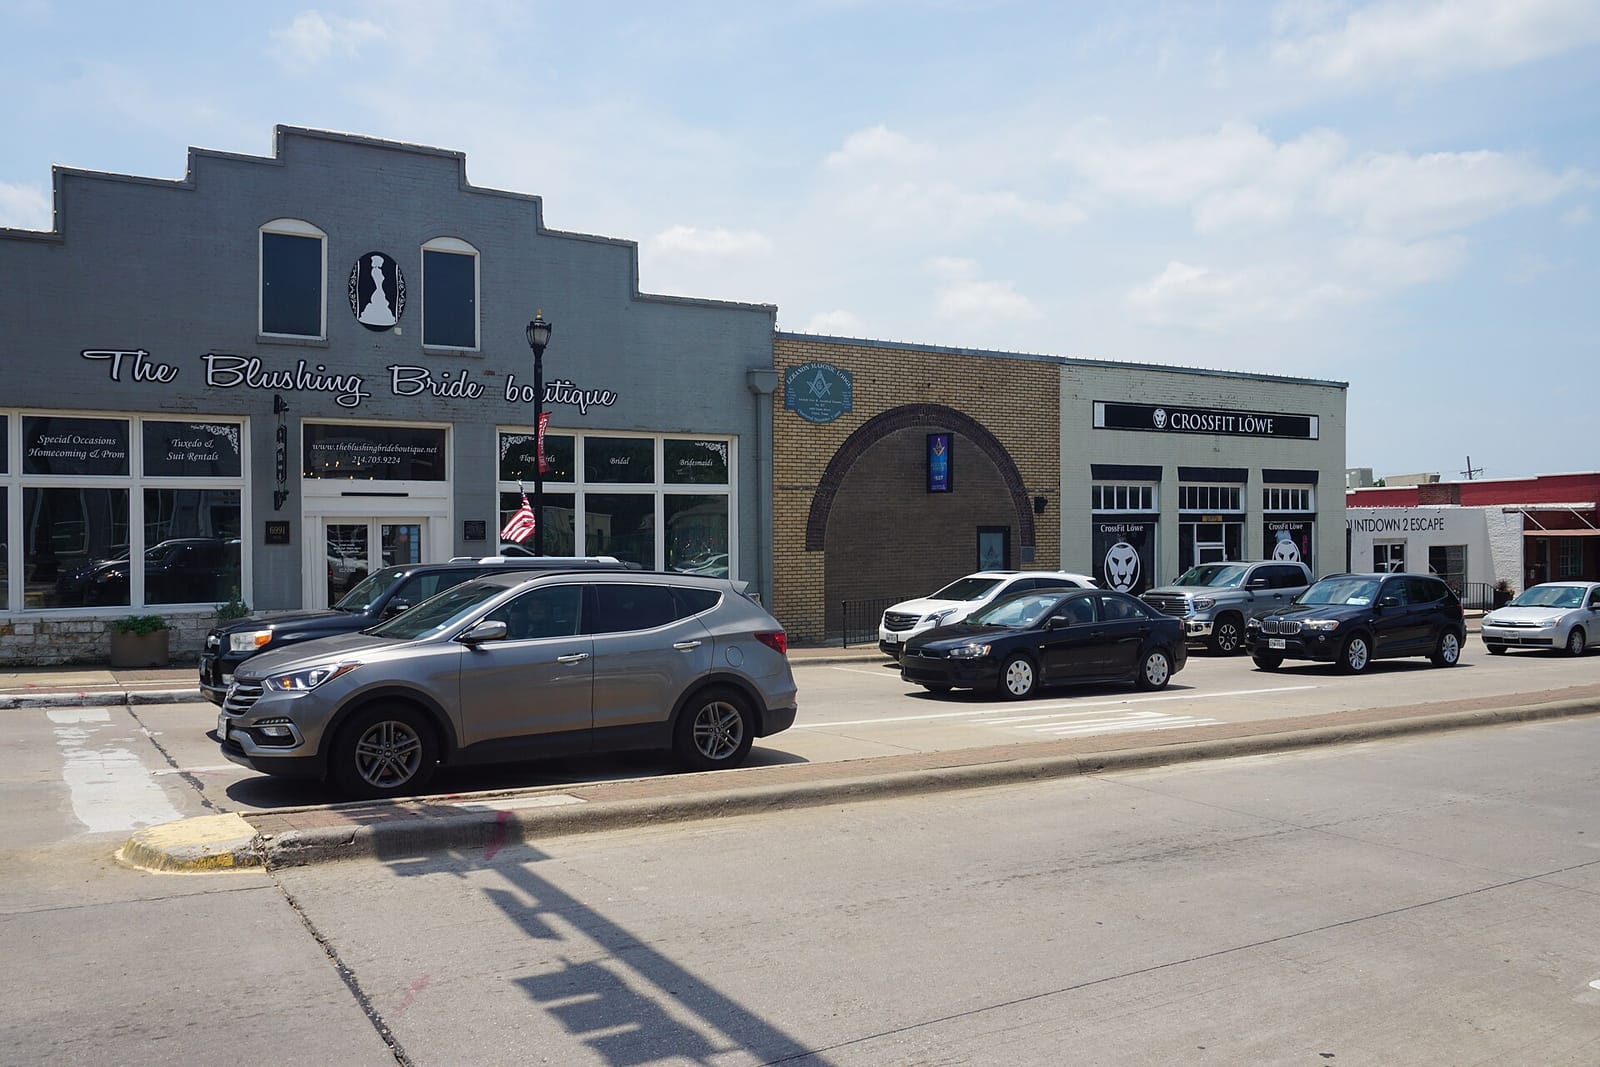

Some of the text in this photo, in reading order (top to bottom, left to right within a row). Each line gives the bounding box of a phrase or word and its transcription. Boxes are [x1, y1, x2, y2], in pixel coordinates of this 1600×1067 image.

[81, 350, 178, 383] The
[201, 354, 371, 407] Blushing
[387, 365, 485, 399] Bride
[1171, 412, 1273, 433] CROSSFIT LÖWE
[37, 434, 116, 446] Special Occasions
[171, 438, 214, 449] Tuxedo &
[28, 448, 125, 460] Homecoming & Prom
[312, 442, 438, 455] www.theblushingbrideboutique.net
[166, 451, 219, 461] Suit Rentals
[351, 455, 401, 464] 214.705.9224
[610, 456, 631, 465] Bridal
[1100, 524, 1125, 533] CrossFit
[1402, 518, 1408, 531] 2
[1410, 518, 1444, 531] ESCAPE
